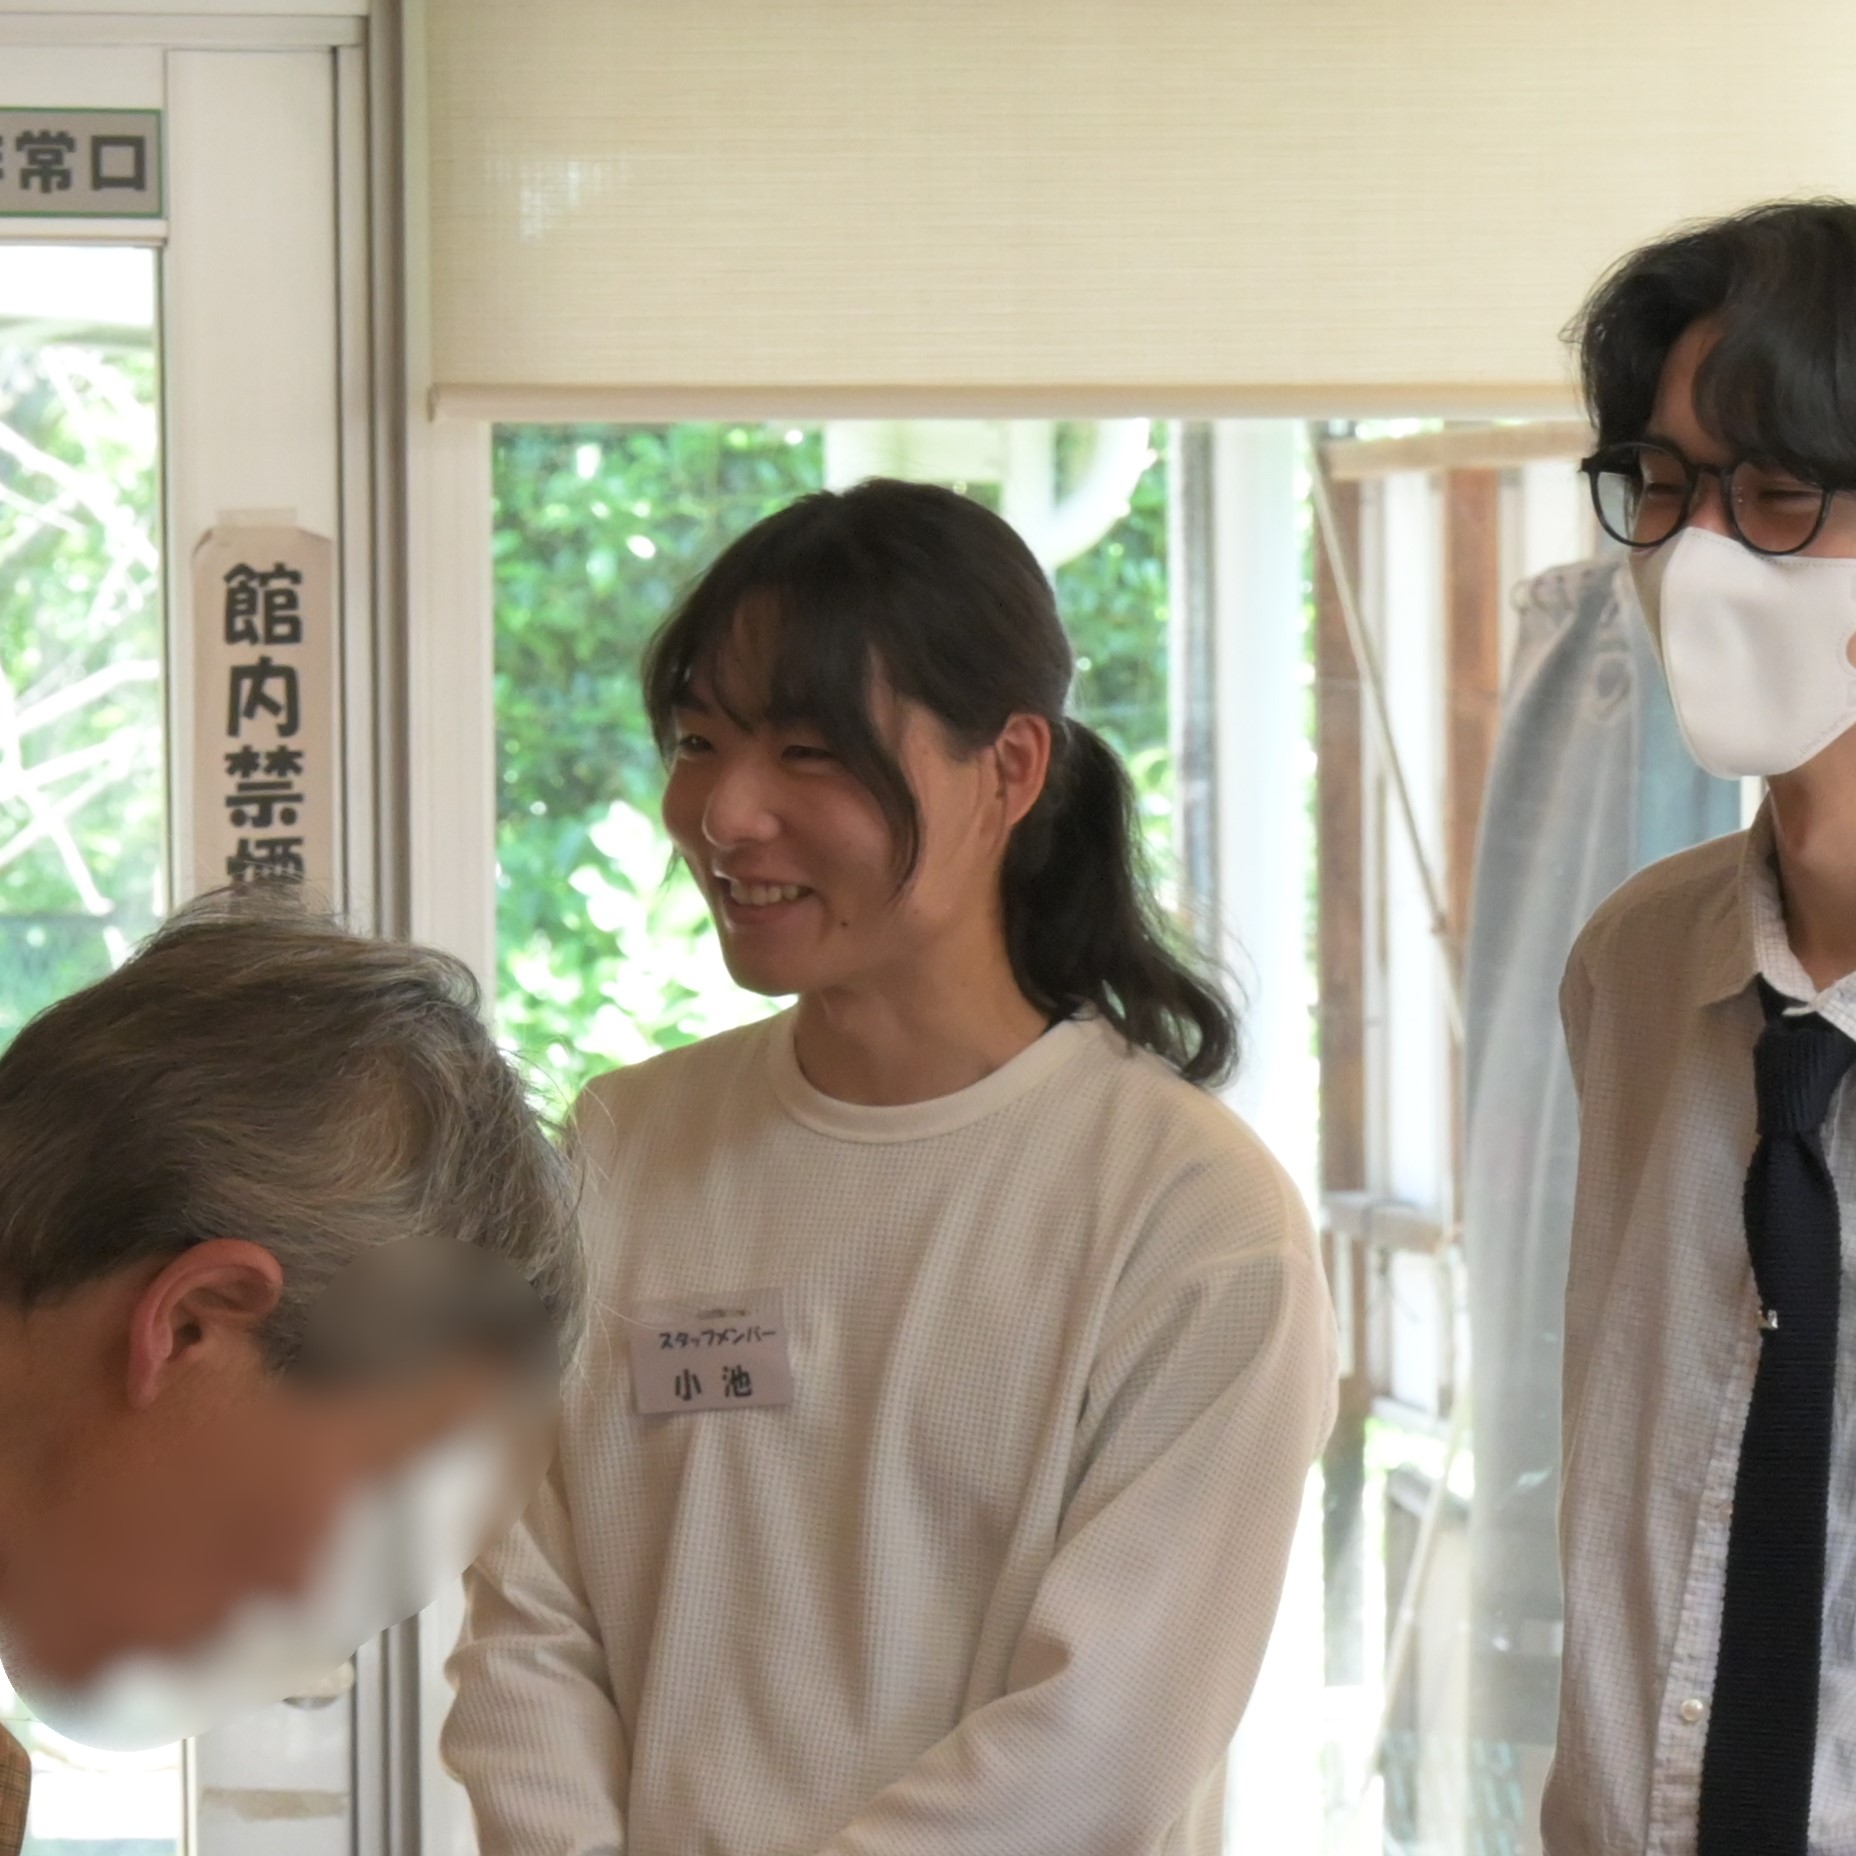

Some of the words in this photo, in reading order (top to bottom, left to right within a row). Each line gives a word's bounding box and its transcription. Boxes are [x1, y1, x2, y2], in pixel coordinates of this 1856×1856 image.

[658, 1326, 777, 1350] スタッフメンバー
[674, 1364, 753, 1402] 小池
